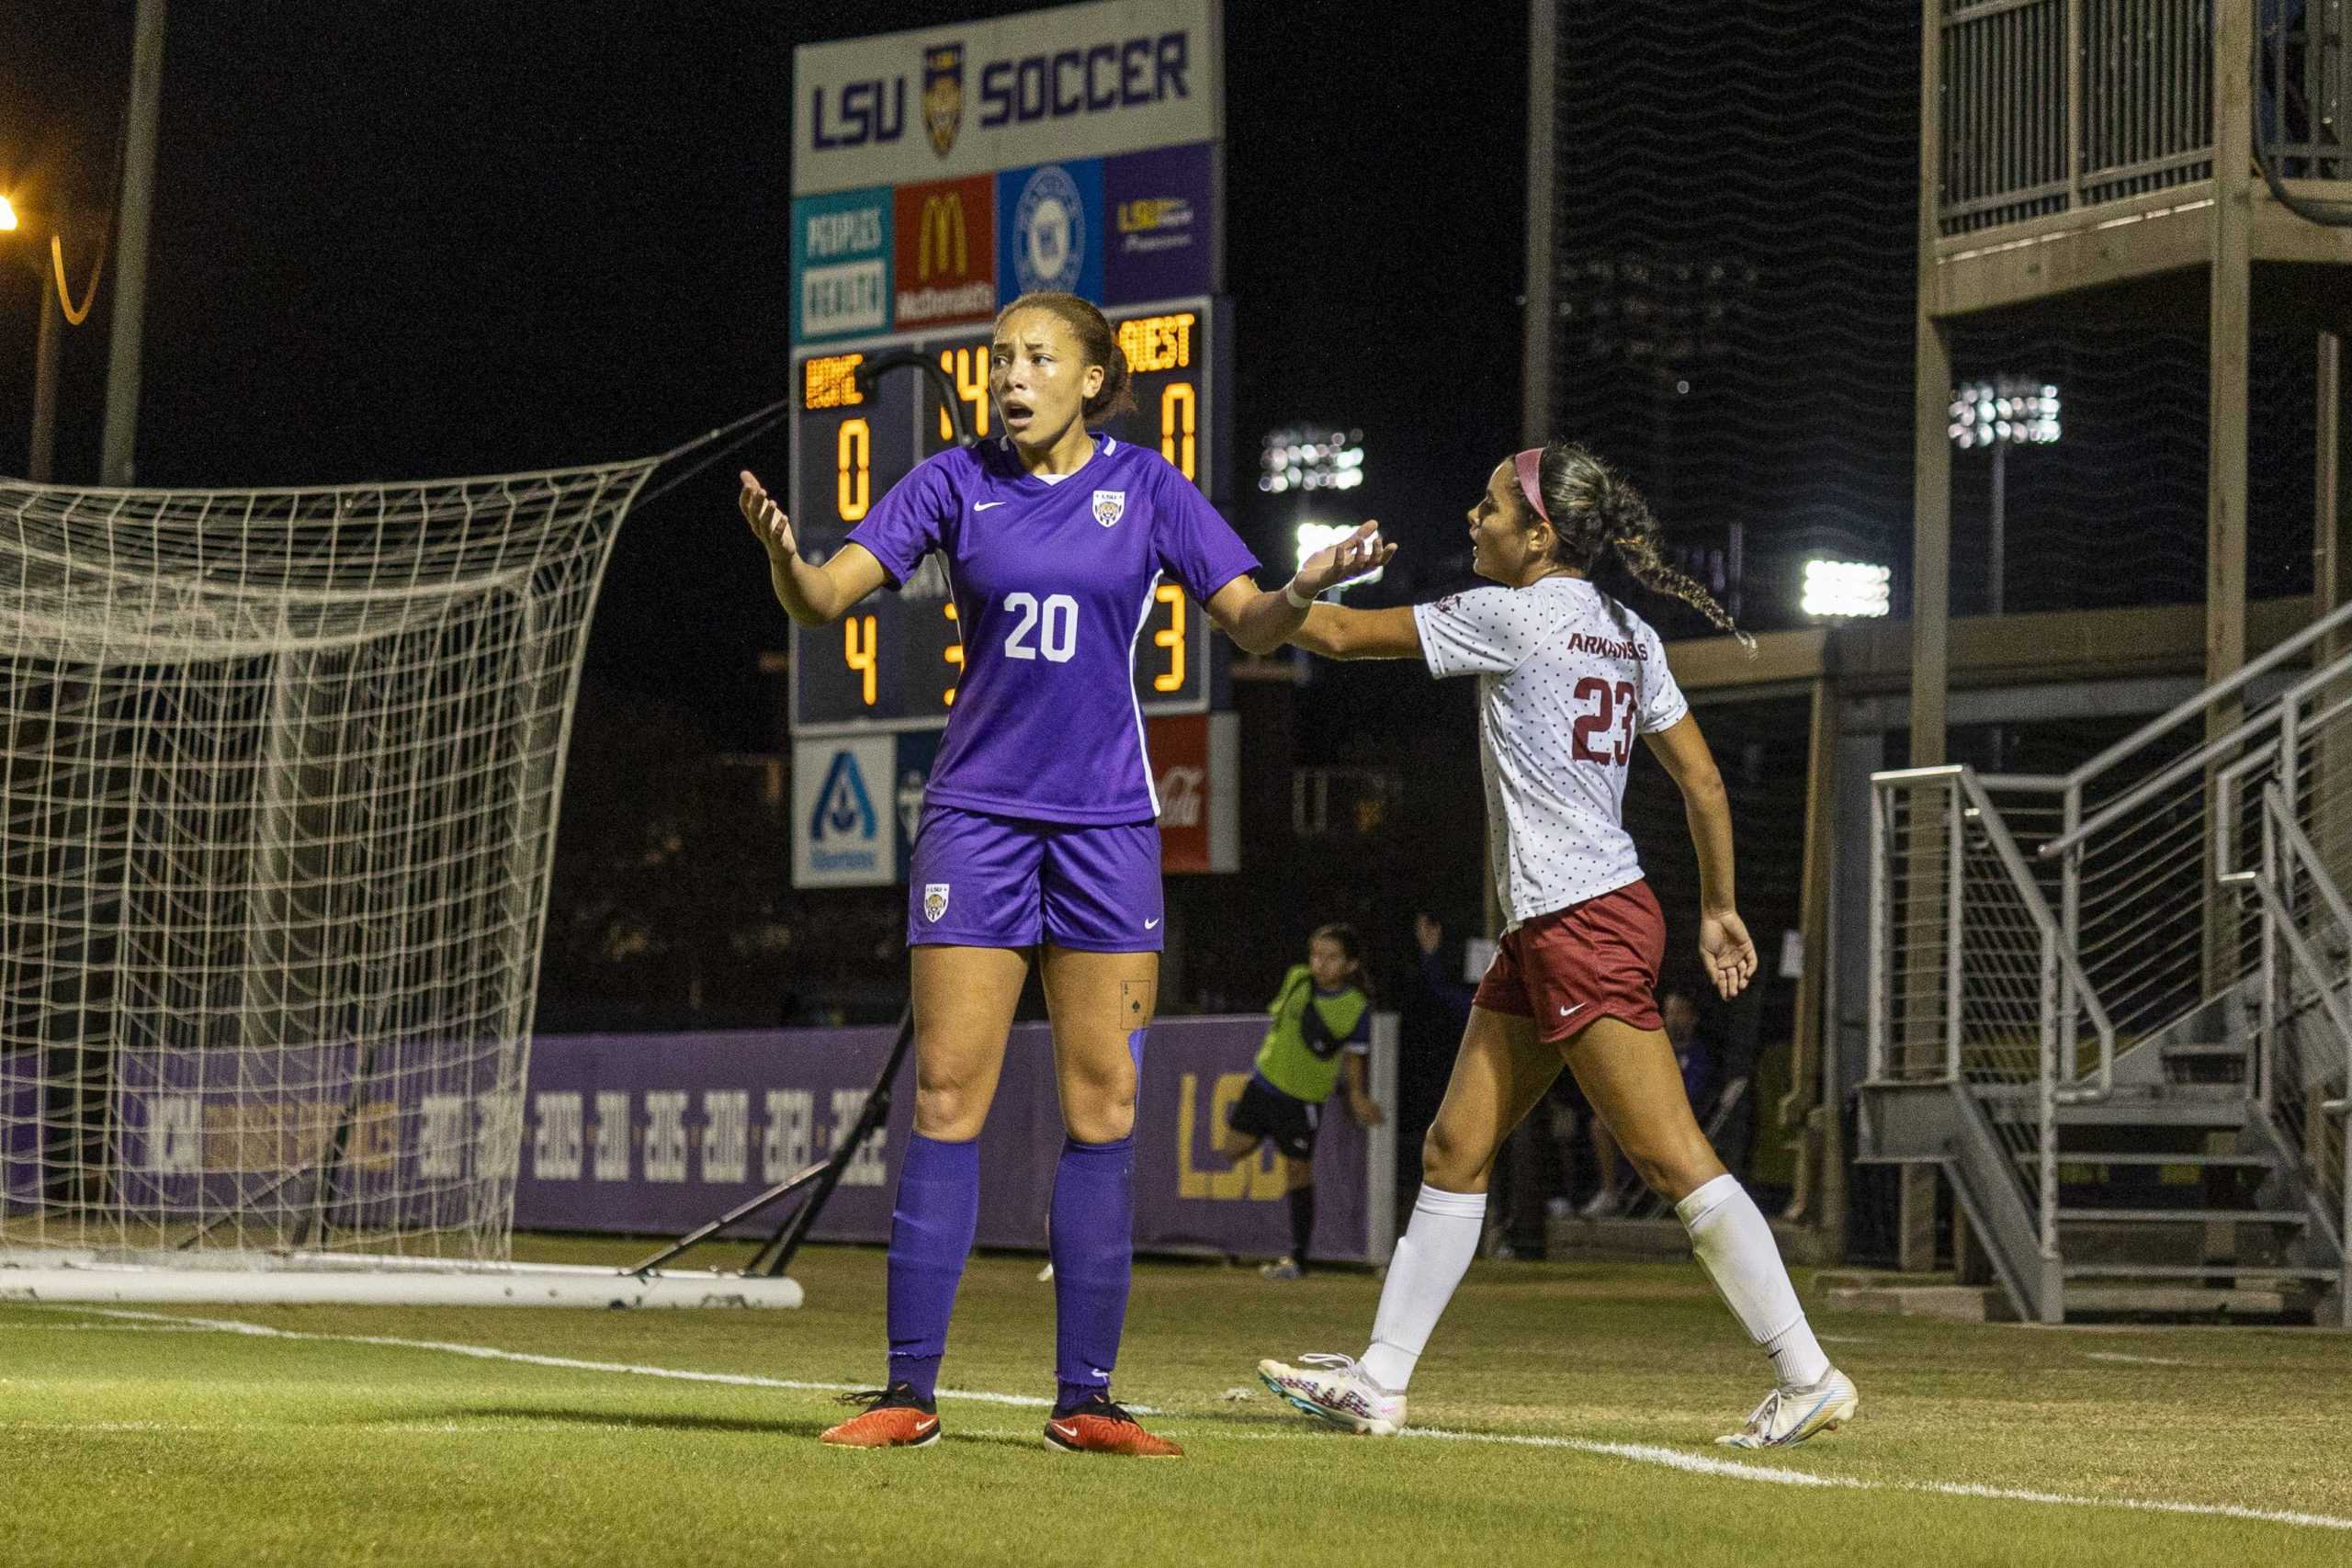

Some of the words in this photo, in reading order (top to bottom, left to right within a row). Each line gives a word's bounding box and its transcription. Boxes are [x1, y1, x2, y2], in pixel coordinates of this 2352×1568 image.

[812, 75, 907, 152] LSU
[979, 31, 1190, 130] SOCCER
[838, 419, 869, 521] 0
[1161, 382, 1194, 482] 0
[845, 616, 876, 705] 4
[1003, 592, 1079, 663] 20
[1154, 585, 1185, 692] 3
[1572, 676, 1637, 766] 23
